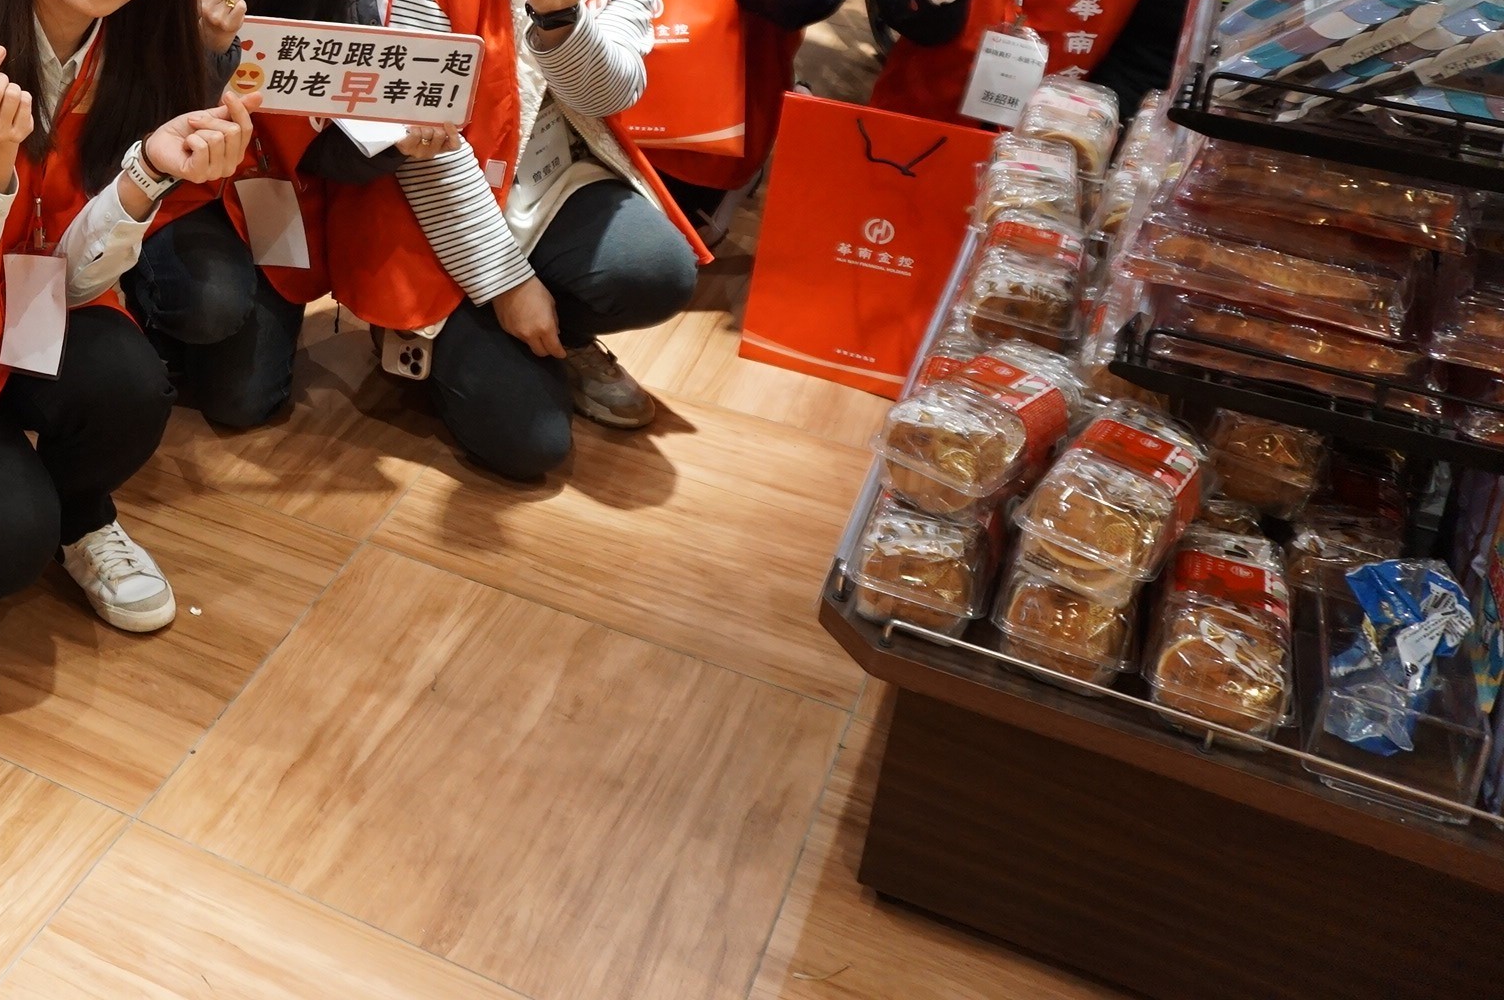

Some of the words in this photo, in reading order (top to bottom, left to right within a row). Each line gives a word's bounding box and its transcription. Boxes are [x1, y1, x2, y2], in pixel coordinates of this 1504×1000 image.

[276, 34, 474, 77] 歡迎跟我一起
[266, 69, 460, 113] 助老早幸福!
[837, 242, 915, 269] 華南金控
